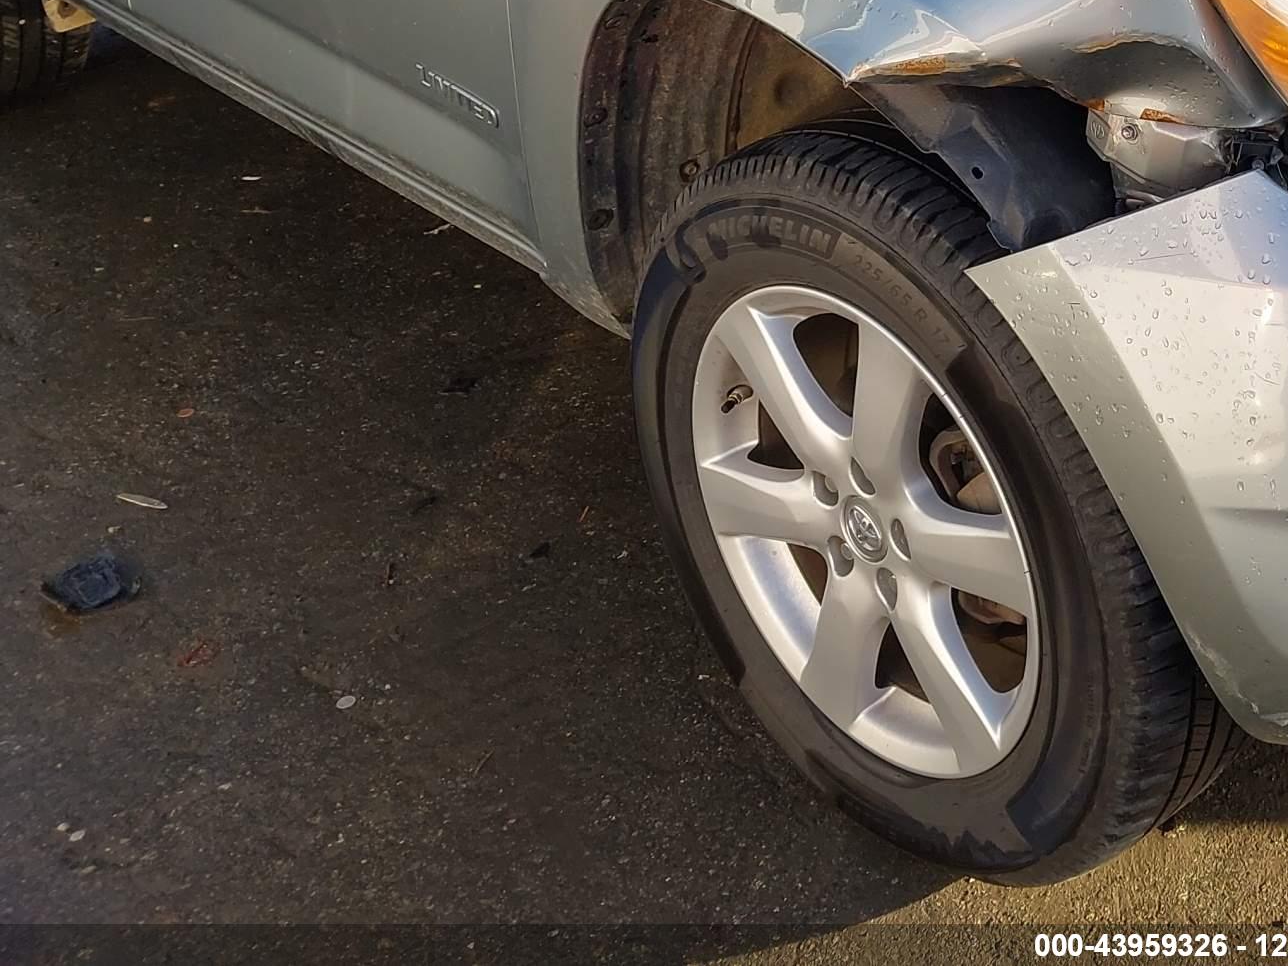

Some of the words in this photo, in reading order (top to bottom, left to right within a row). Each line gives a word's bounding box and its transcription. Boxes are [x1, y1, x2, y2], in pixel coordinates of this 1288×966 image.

[415, 62, 499, 129] LIMITED
[706, 215, 832, 253] MICHELIN
[853, 254, 913, 307] 225/65
[914, 307, 928, 323] R
